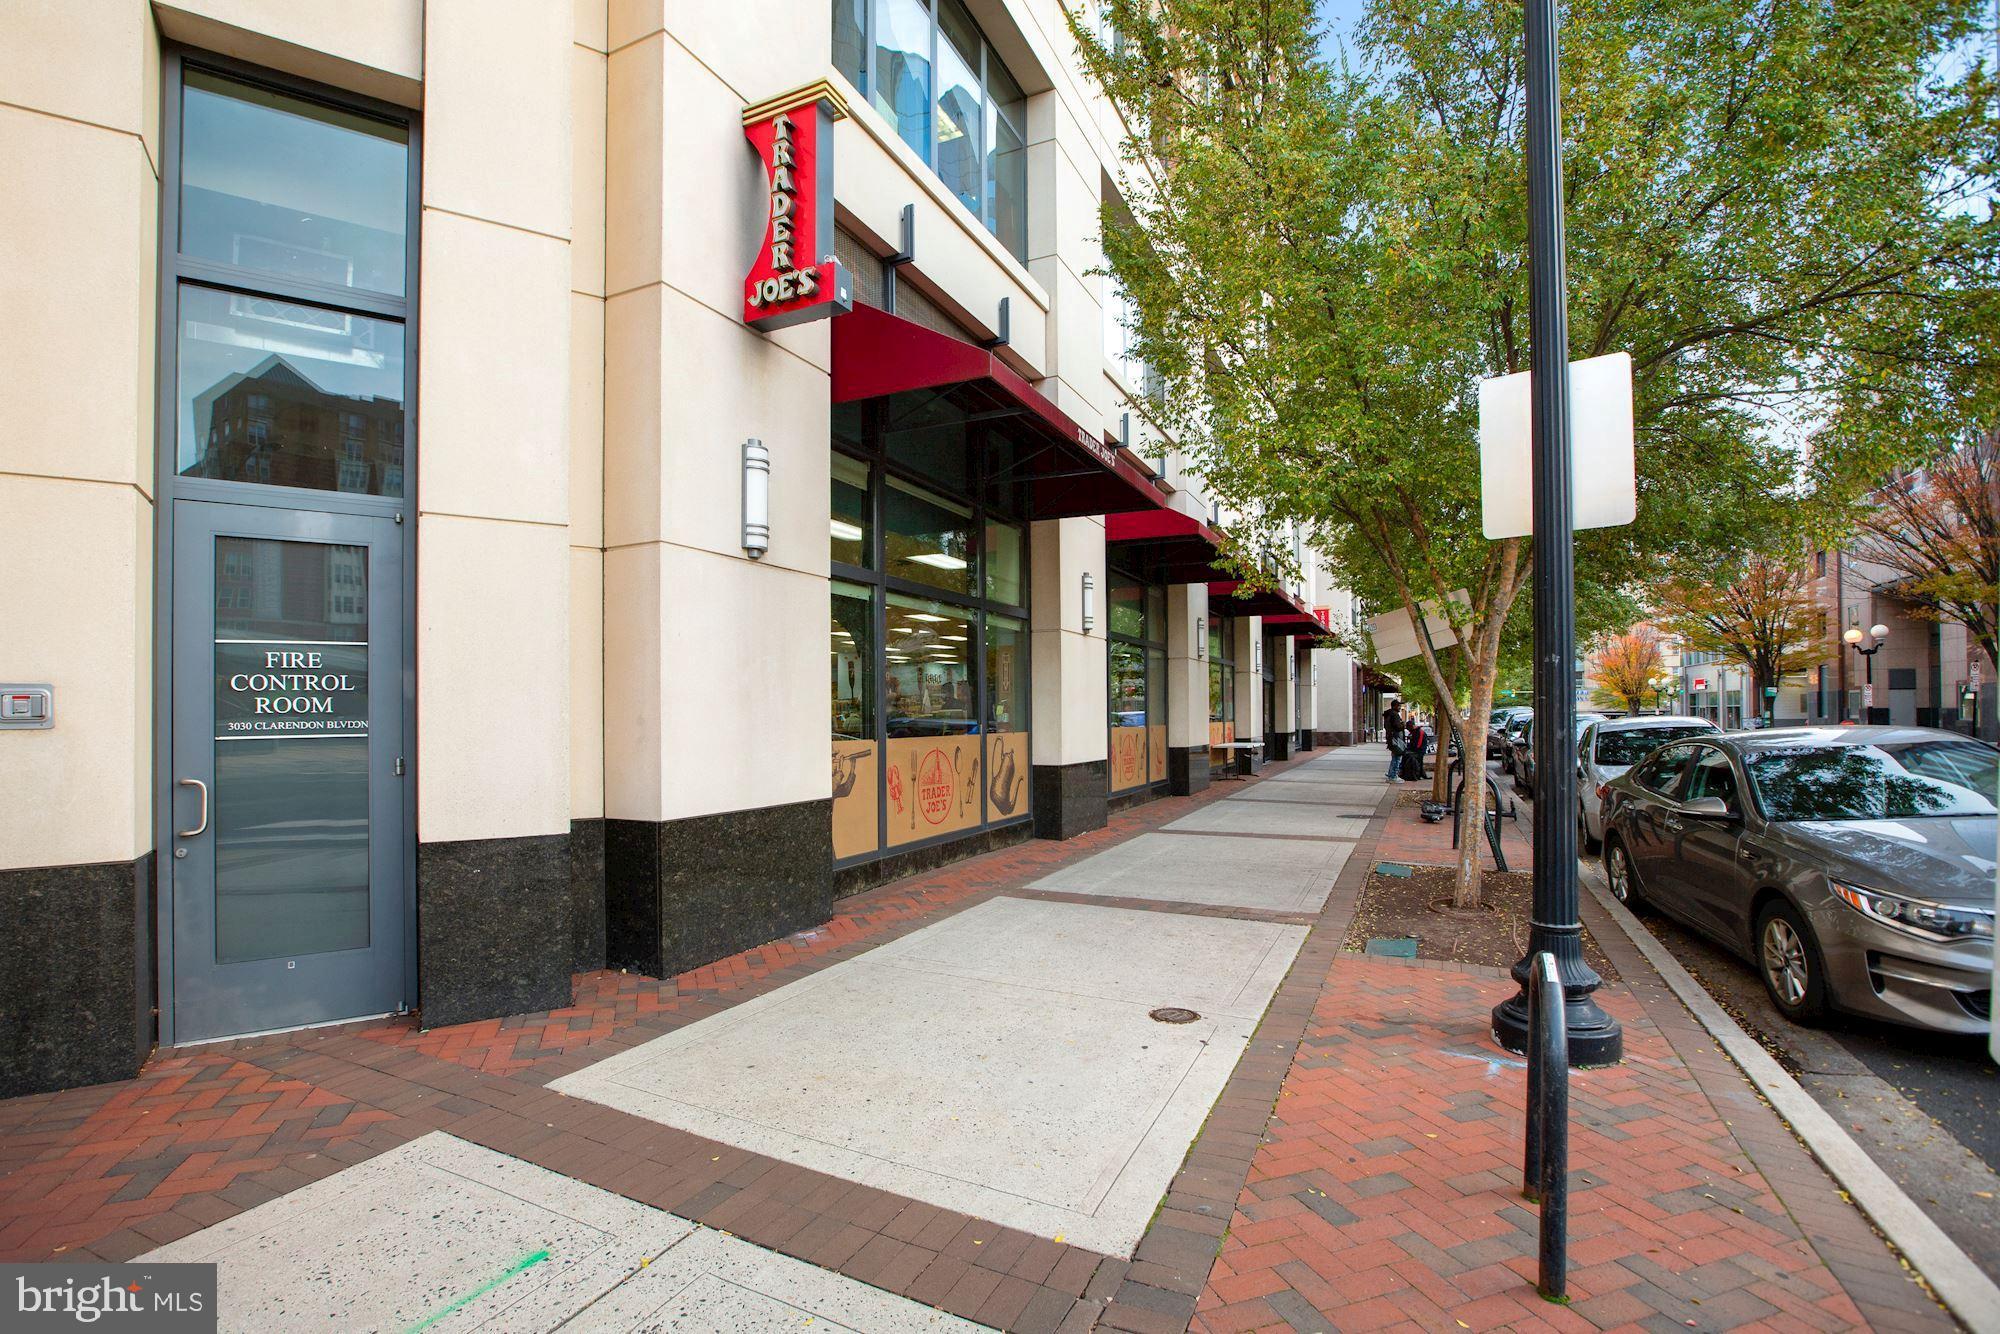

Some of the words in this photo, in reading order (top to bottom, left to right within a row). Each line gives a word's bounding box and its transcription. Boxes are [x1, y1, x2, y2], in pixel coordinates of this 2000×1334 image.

[771, 113, 797, 272] TRADER
[747, 266, 819, 308] JOE'S
[265, 651, 323, 669] FIRE
[230, 674, 355, 691] CONTROL
[254, 696, 334, 714] ROOM
[228, 722, 252, 731] 3030
[254, 720, 324, 730] CLARENDON
[921, 785, 951, 801] TRADER
[926, 799, 948, 814] JOE'S
